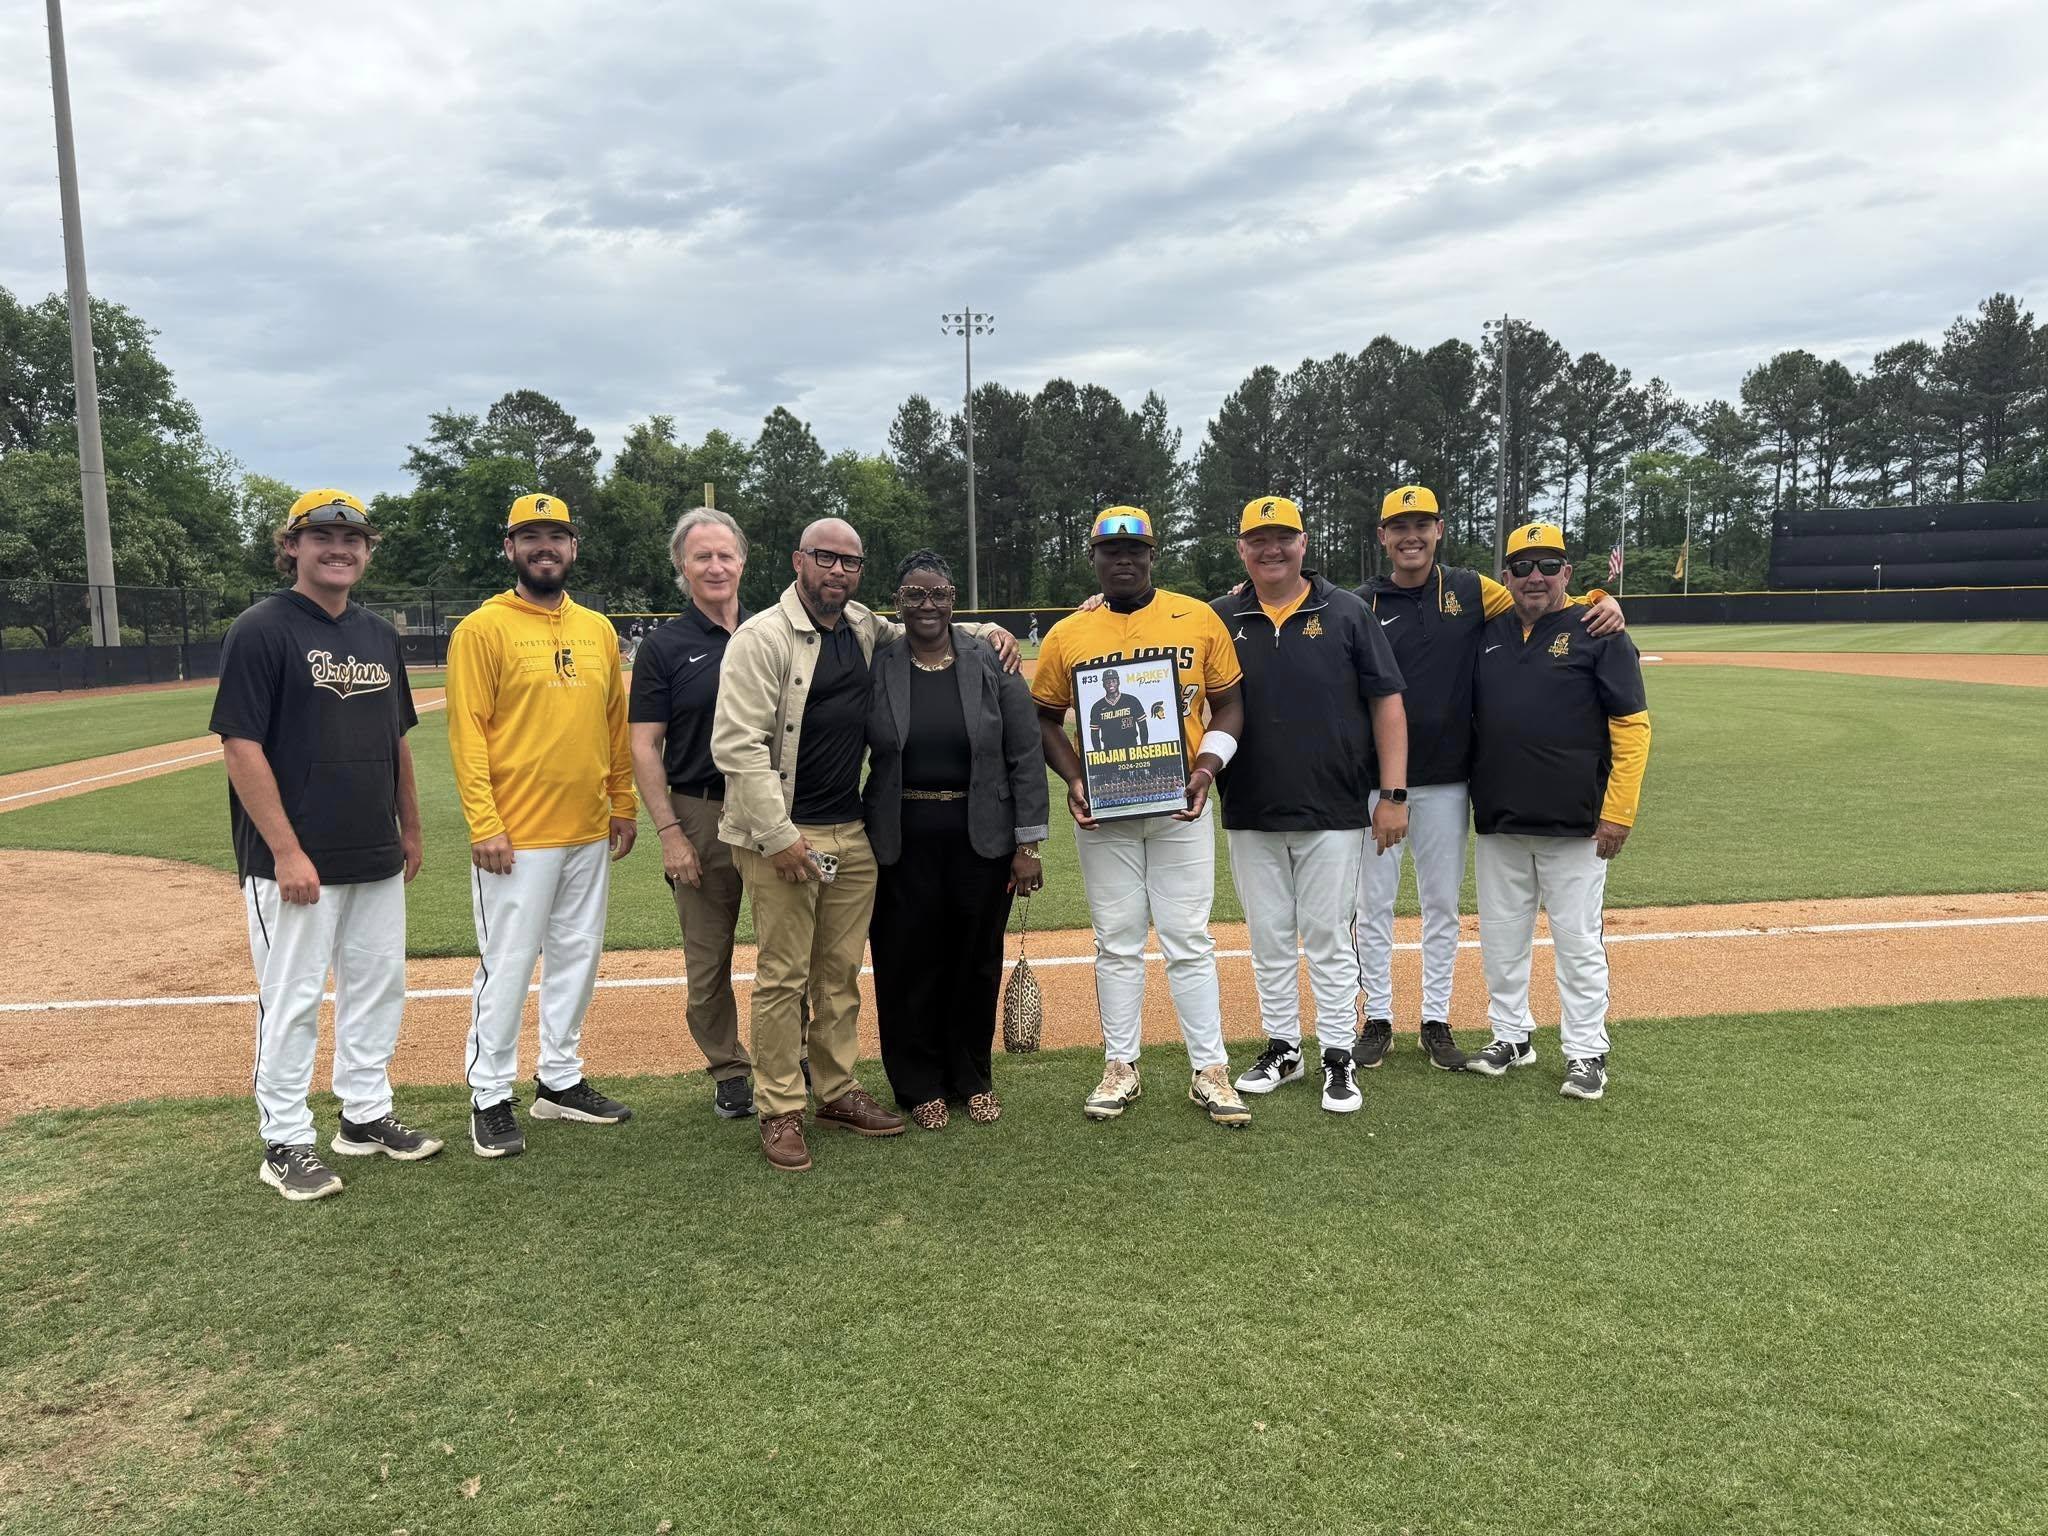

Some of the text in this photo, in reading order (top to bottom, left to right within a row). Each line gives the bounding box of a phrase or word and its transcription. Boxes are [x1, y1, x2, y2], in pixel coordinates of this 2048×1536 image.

[307, 649, 387, 693] Trojans
[1082, 675, 1098, 684] #33
[1180, 683, 1200, 718] 3
[1100, 708, 1130, 719] TROJANS
[1087, 742, 1179, 765] TROJAN BASEBALL
[1118, 761, 1151, 770] 2024-2025
